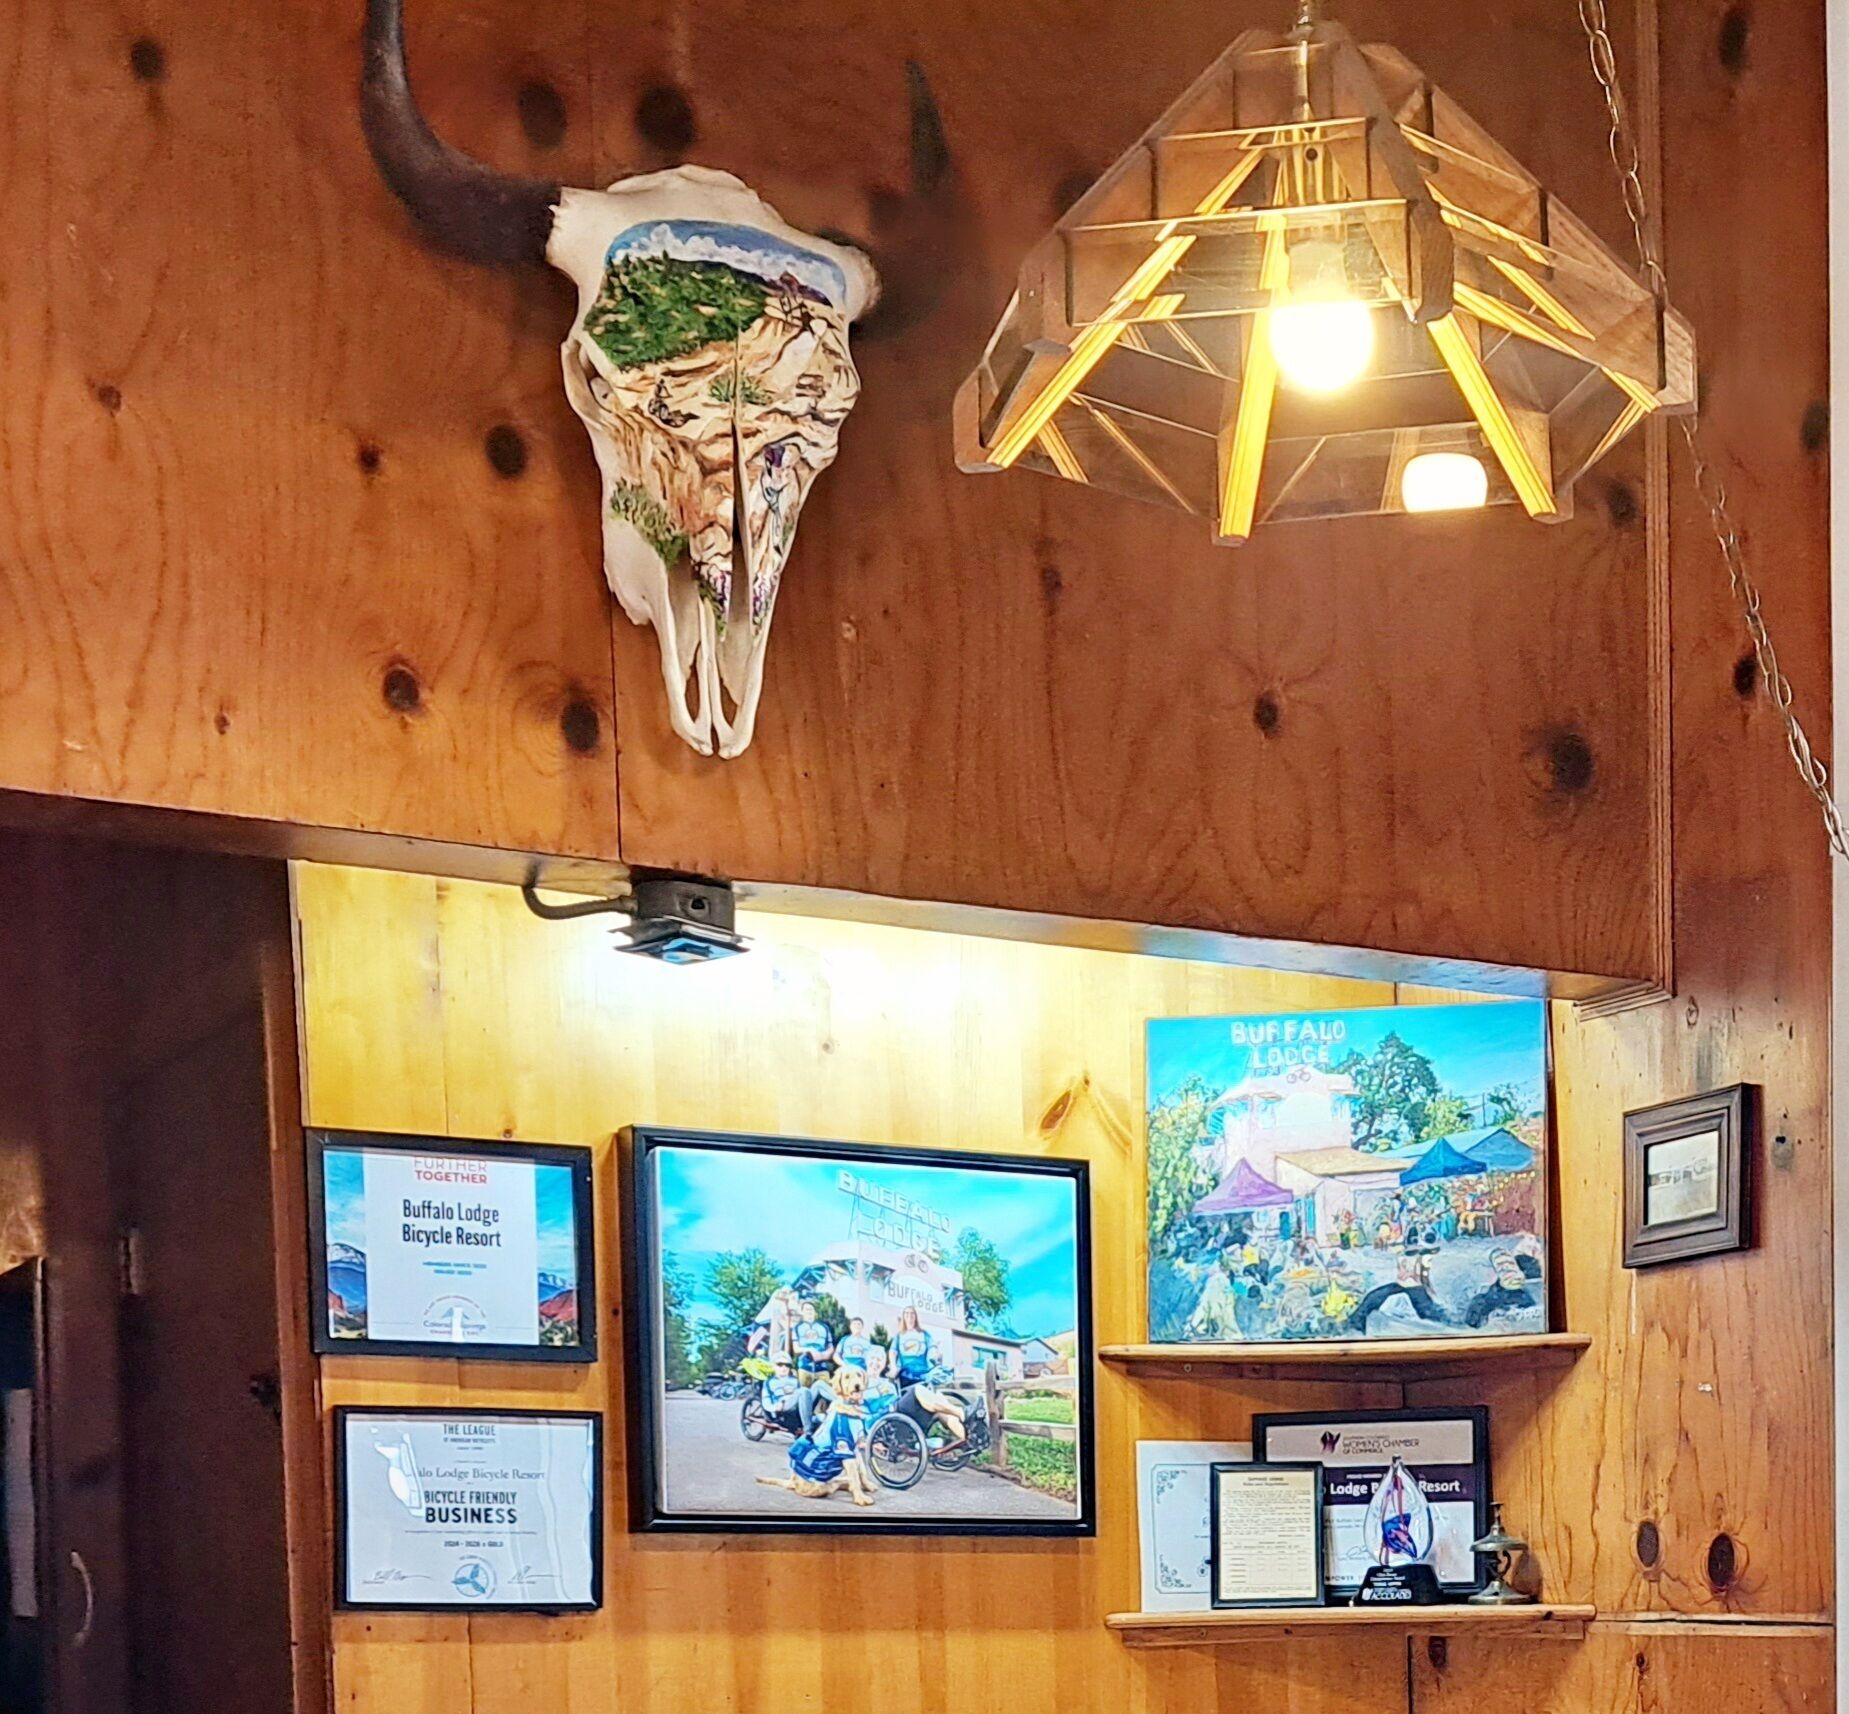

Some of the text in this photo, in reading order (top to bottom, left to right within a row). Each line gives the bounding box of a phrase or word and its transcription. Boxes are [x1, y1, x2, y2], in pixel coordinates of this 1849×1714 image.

[1230, 1019, 1347, 1046] BUFFALO
[1250, 1042, 1331, 1069] LODGE
[413, 1158, 488, 1173] FURTHER
[414, 1169, 488, 1184] TOGETHER
[402, 1198, 500, 1227] Buffalo Lodge
[401, 1223, 502, 1249] Bicycle Resort
[443, 1424, 496, 1437] THE LEAGUE
[1382, 1437, 1421, 1449] CHAMBER
[436, 1468, 470, 1481] Lodge
[472, 1468, 511, 1482] Bicycle
[1330, 1479, 1461, 1497] Lodge Resort
[424, 1490, 518, 1505] BICYCLE FRIENDLY
[425, 1507, 519, 1524] BUSINESS
